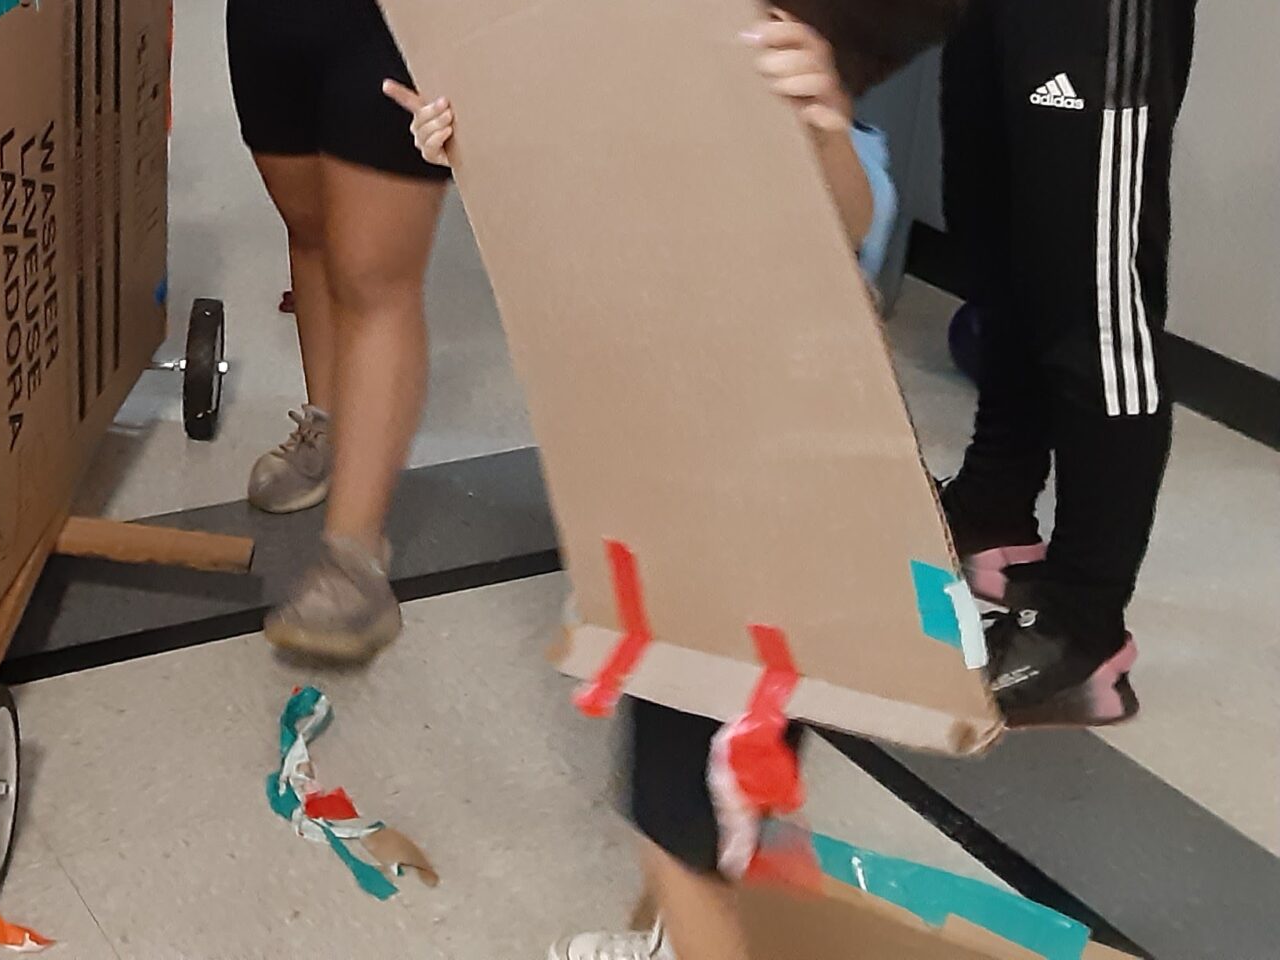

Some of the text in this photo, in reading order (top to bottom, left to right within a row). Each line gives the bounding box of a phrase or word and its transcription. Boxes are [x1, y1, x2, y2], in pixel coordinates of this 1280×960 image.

[1029, 93, 1085, 110] adidas
[0, 127, 24, 453] LAVADORA
[21, 135, 41, 401] LAVEUSE
[40, 120, 59, 369] WASHER
